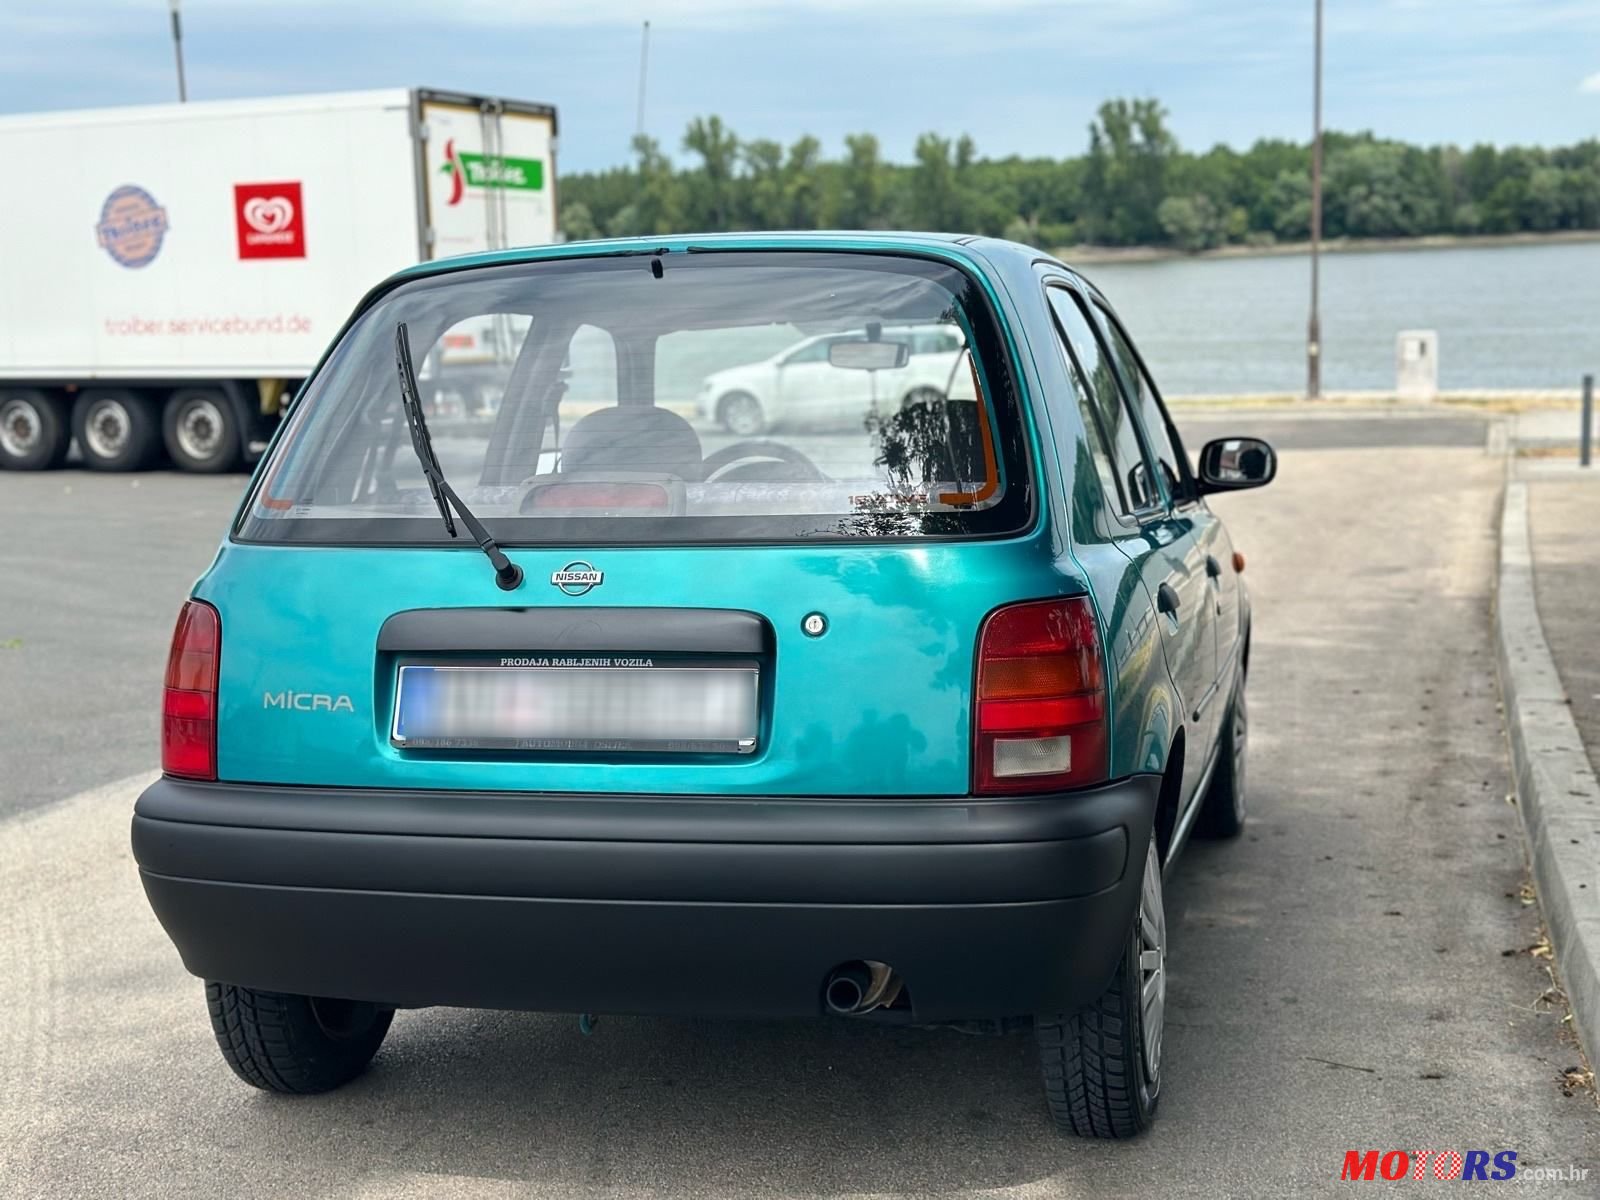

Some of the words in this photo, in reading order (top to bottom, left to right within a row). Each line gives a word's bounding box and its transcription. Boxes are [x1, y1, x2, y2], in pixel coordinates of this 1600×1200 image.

[555, 573, 598, 581] NISSAN
[500, 658, 550, 667] PRODAJA
[551, 658, 611, 667] RABLJENIH
[614, 658, 654, 667] VOZILA
